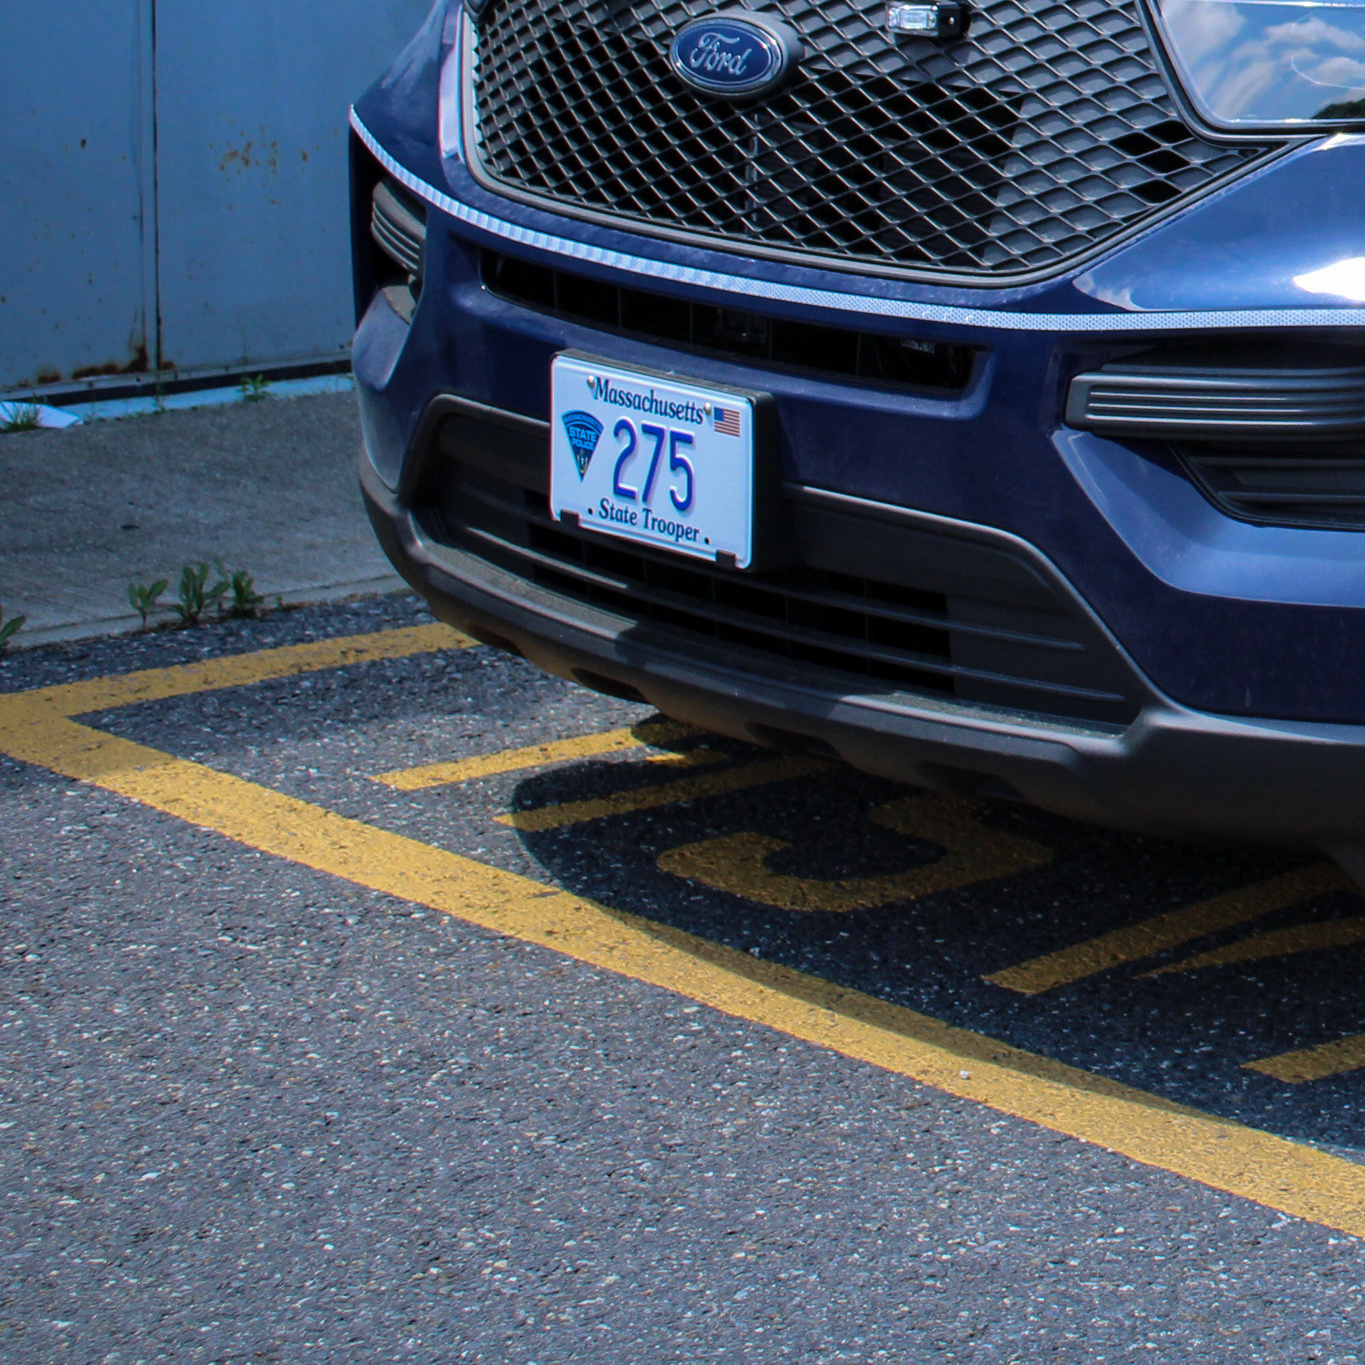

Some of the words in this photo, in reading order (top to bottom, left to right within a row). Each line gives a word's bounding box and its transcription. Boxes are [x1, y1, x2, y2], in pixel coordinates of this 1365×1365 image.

[689, 32, 753, 76] Ford
[594, 376, 705, 425] Massachusetts
[569, 426, 598, 443] STATE
[613, 416, 695, 512] 275
[599, 497, 638, 526] State
[642, 507, 700, 543] Trooper
